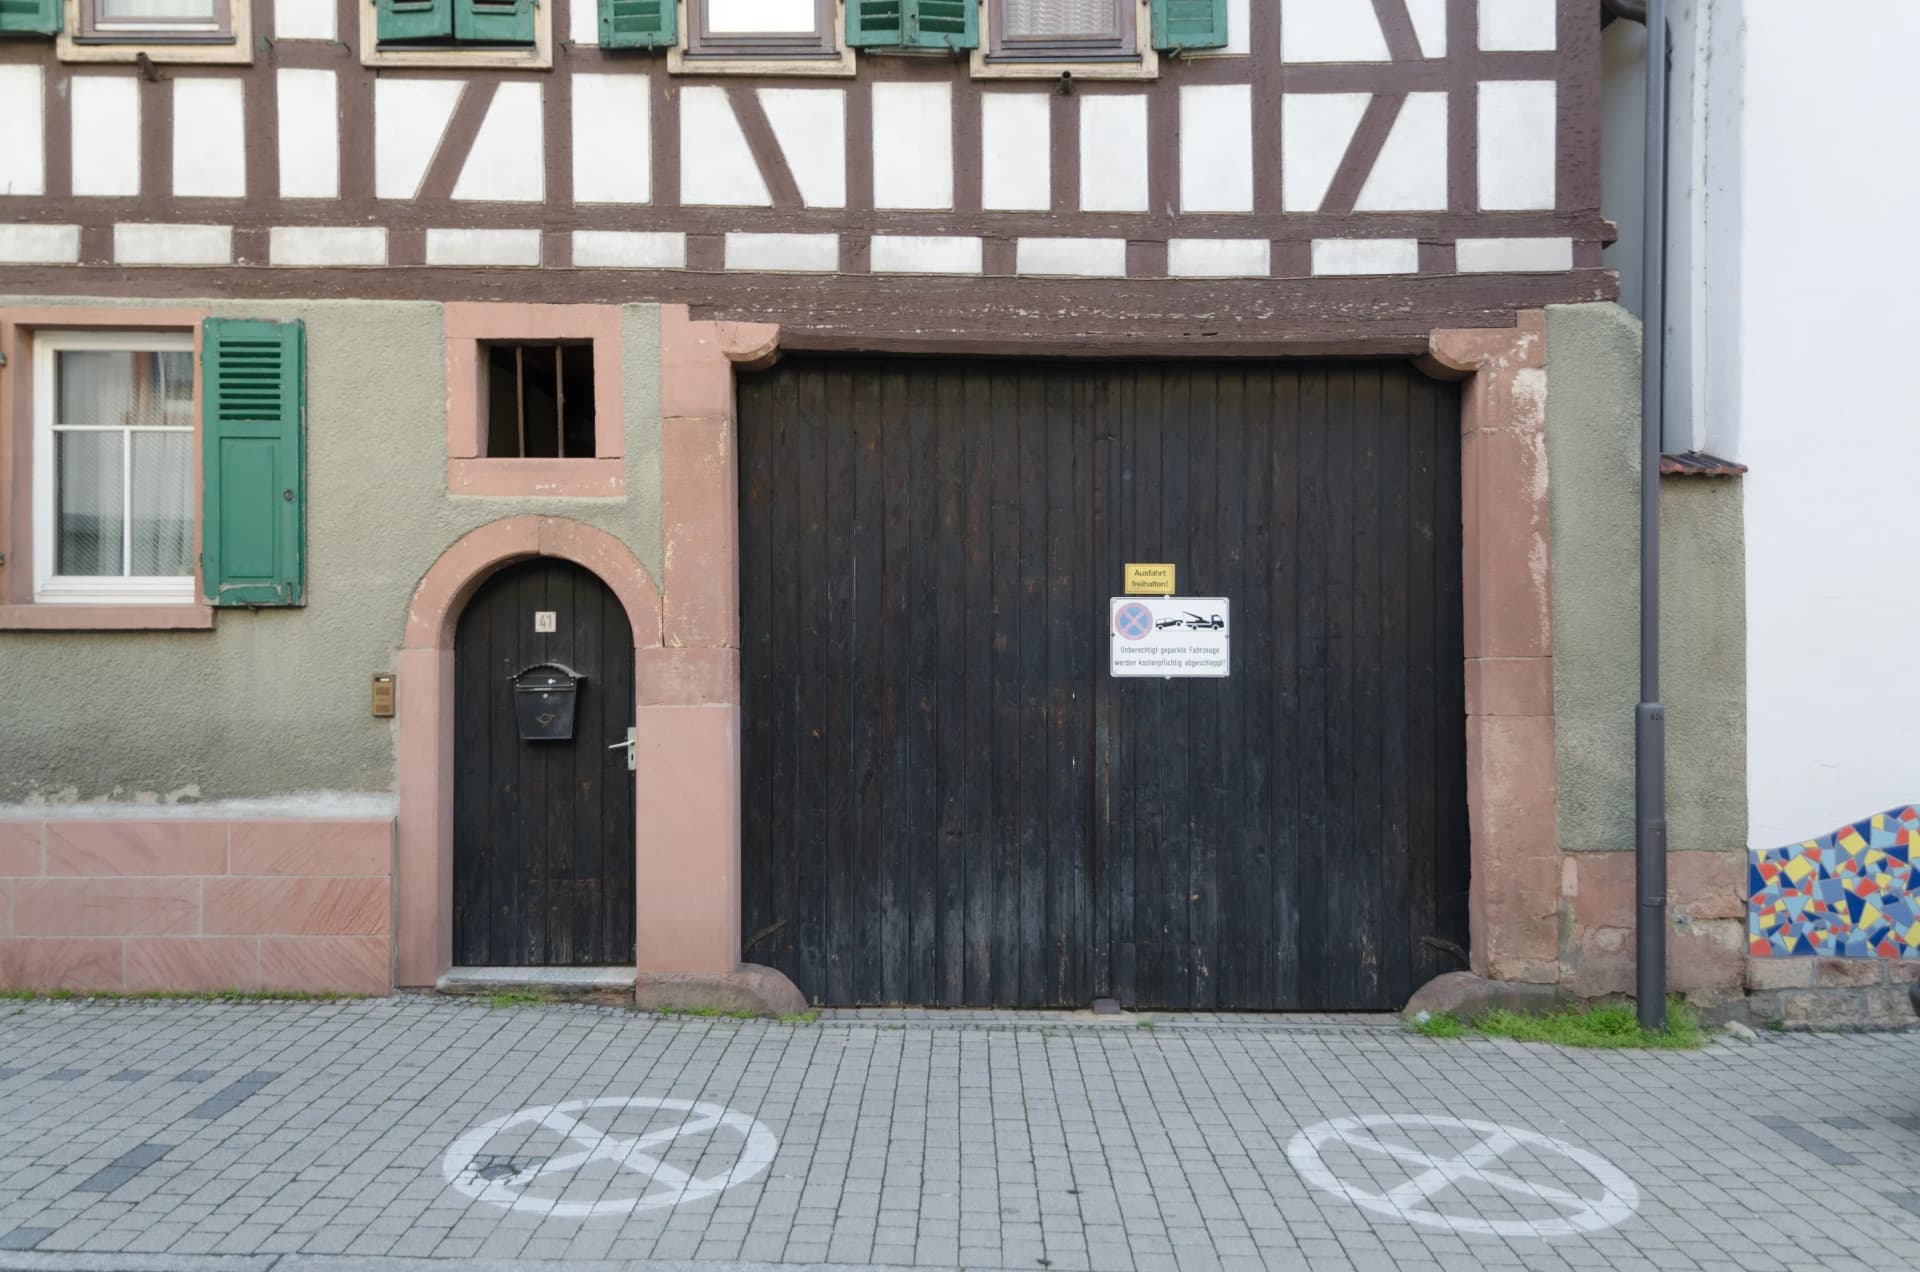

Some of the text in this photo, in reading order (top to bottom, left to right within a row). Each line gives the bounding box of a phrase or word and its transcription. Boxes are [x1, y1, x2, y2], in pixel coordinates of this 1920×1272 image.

[1134, 569, 1167, 577] Ausfahrt
[1131, 580, 1169, 588] freihalten!
[539, 614, 552, 629] 41
[1120, 646, 1220, 655] Unberechtigt geparkte Fahrzeuge
[1114, 658, 1136, 666] werden
[1138, 658, 1182, 668] kostenpflichtig
